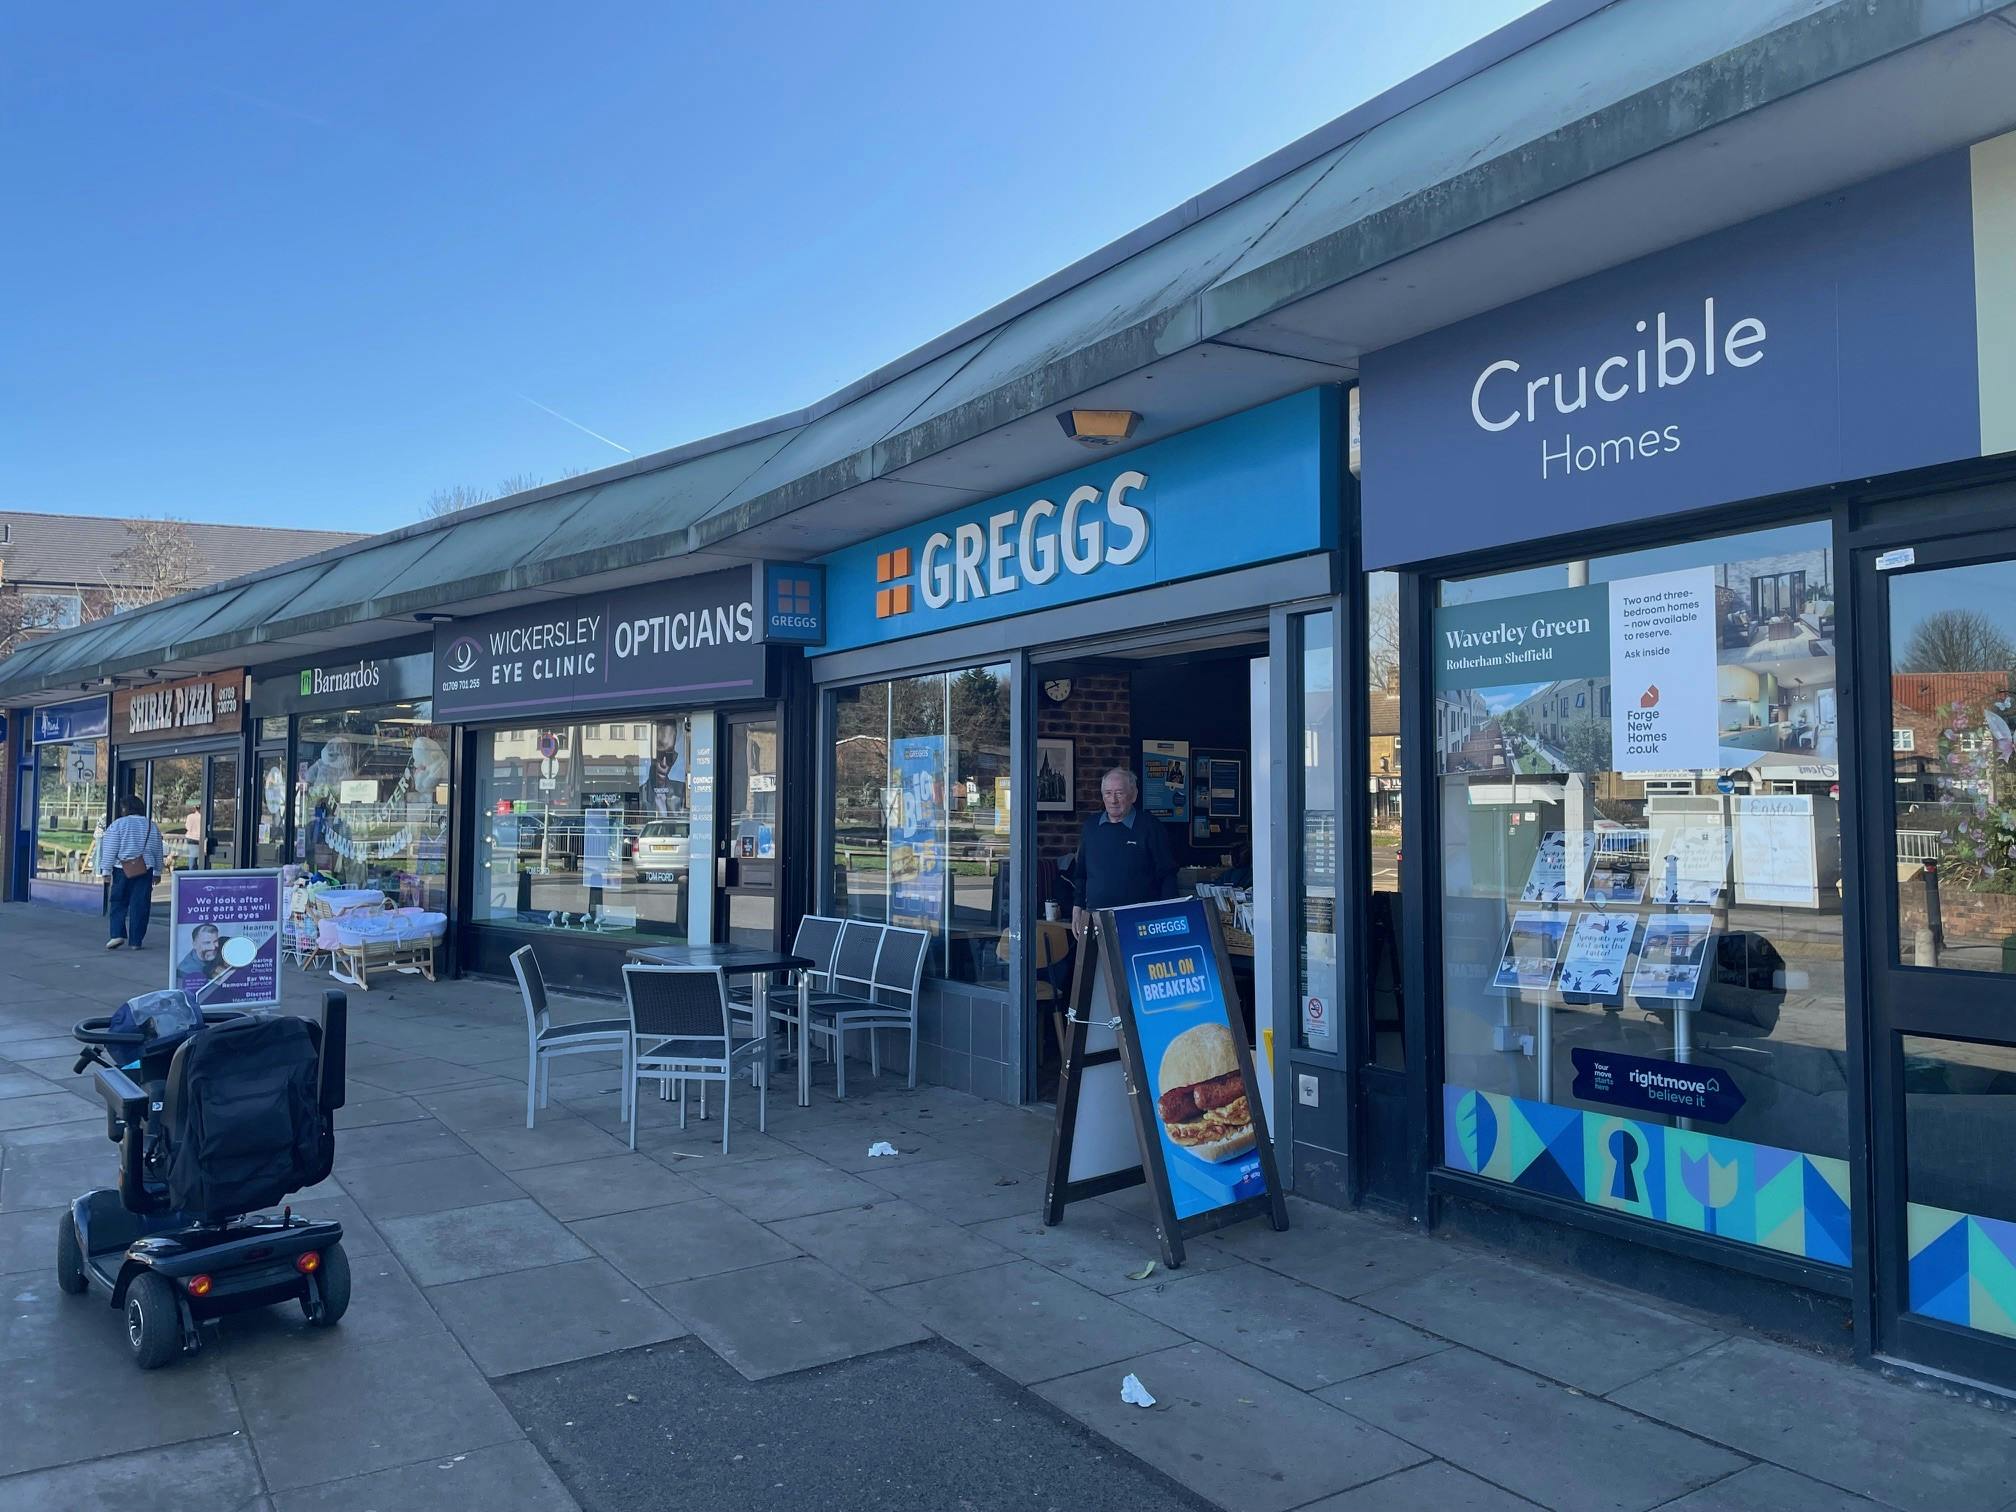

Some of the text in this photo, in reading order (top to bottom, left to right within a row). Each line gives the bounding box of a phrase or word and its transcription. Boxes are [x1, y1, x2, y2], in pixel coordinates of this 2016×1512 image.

[1471, 297, 1767, 432] Crucible
[1541, 425, 1681, 480] Homes
[920, 470, 1149, 609] GREGGS
[1623, 589, 1694, 606] Two and three-
[1623, 600, 1700, 618] bedroom homes
[771, 615, 817, 629] GREGGS
[1631, 618, 1651, 629] now
[1652, 613, 1698, 625] available
[489, 615, 601, 656] WICKERSLEY
[614, 602, 753, 658] OPTICIANS
[1445, 617, 1591, 649] Waverley Green
[1624, 630, 1673, 641] to reserve.
[1446, 647, 1553, 671] Rotherham Sheffield
[1624, 646, 1671, 659] Ask inside
[313, 659, 380, 694] Barnardo's
[491, 652, 596, 685] EYE CLINIC
[442, 678, 480, 692] 01709 701 255
[129, 682, 214, 734] SHIRAZ PIZZA
[1627, 710, 1660, 722] Forge
[1627, 722, 1653, 732] New
[1628, 732, 1668, 743] Homes
[1626, 743, 1659, 755] .co.uk
[692, 776, 713, 784] CONTACT
[645, 871, 674, 882] TOM FORD
[196, 895, 264, 905] We look after
[187, 906, 211, 914] your
[251, 903, 271, 911] well
[212, 913, 235, 921] your
[237, 912, 260, 920] eyes
[1148, 919, 1187, 935] GREGGS
[1148, 957, 1195, 980] ROLL ON
[1143, 975, 1206, 1002] BREAKFAST
[1594, 1062, 1609, 1071] Your
[1594, 1070, 1612, 1079] move
[1629, 1069, 1706, 1094] rightmove
[1648, 1086, 1706, 1108] believe it
